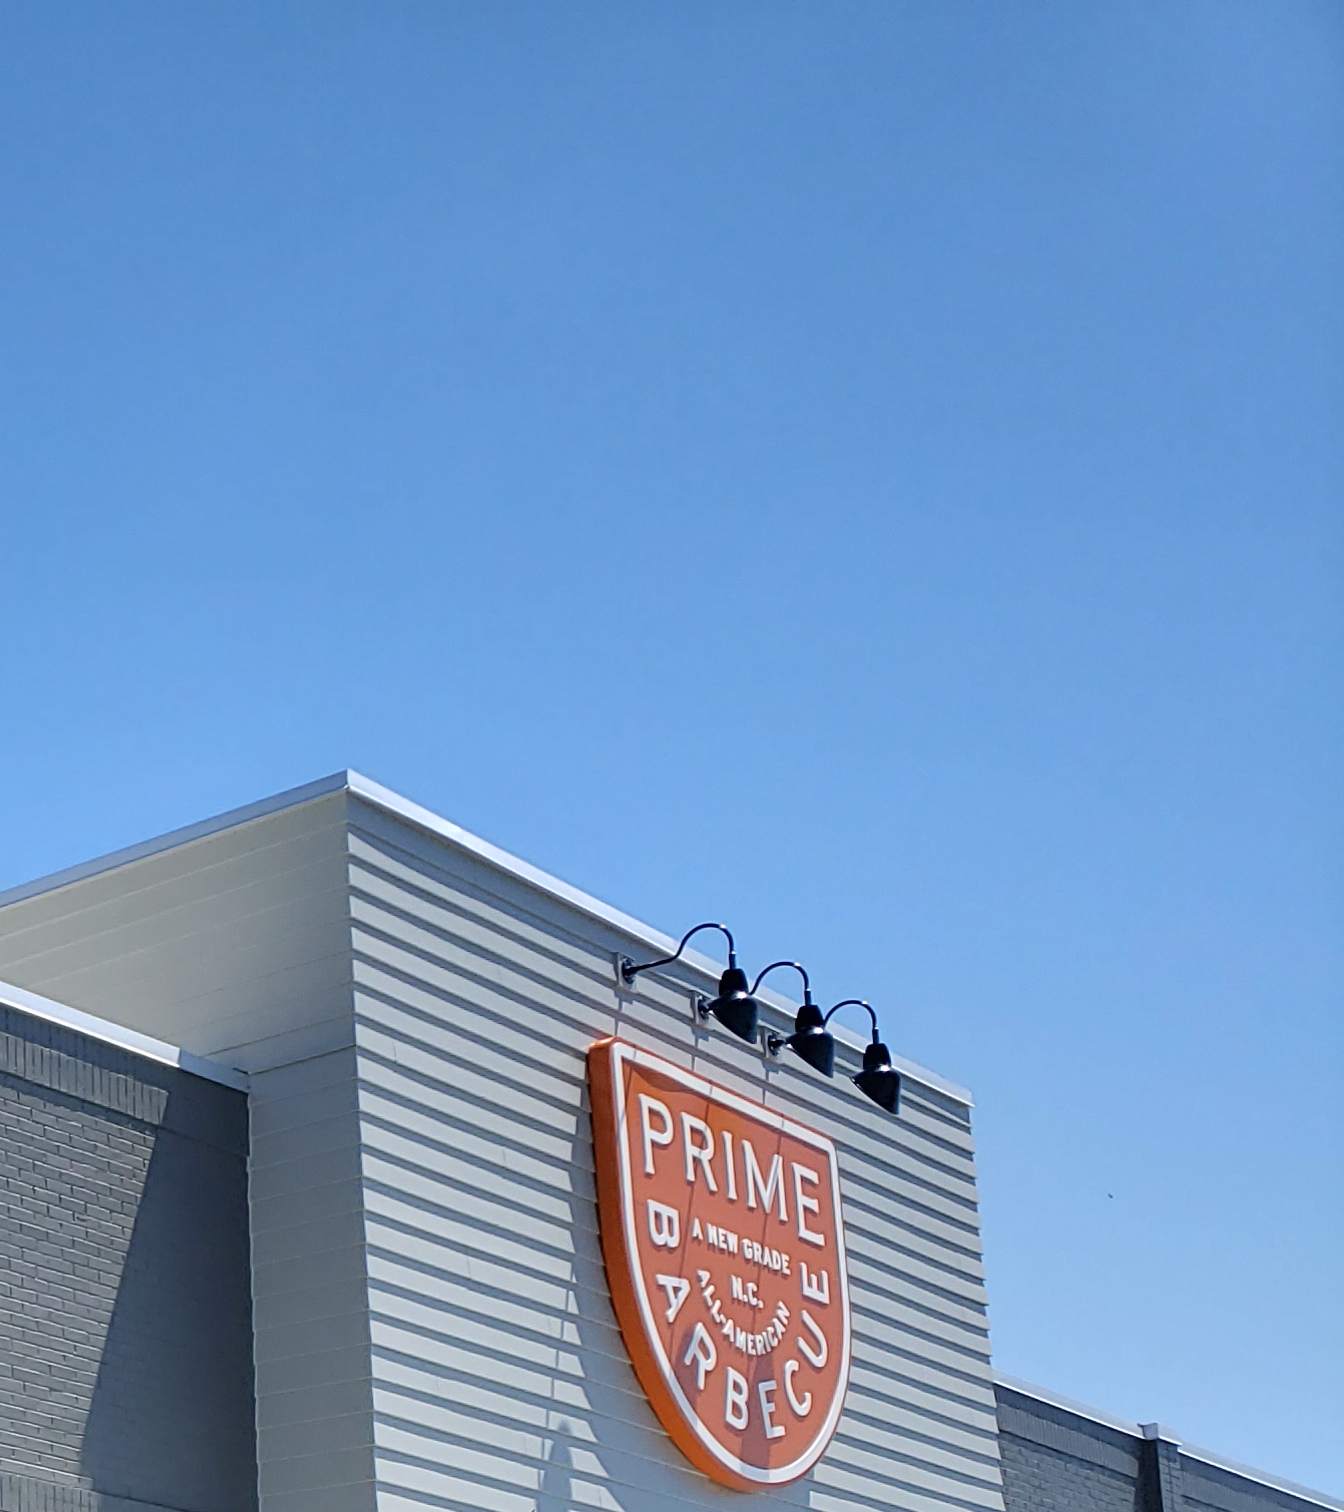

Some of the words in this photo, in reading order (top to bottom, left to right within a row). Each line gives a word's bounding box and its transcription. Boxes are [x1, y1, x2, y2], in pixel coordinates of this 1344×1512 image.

[637, 1092, 825, 1247] PRIME
[691, 1217, 703, 1242] A
[706, 1224, 738, 1254] NEW
[741, 1238, 791, 1276] GRADE
[646, 1199, 830, 1439] BARBECUE
[696, 1269, 791, 1357] ALL-AMERICAN
[730, 1274, 764, 1309] N.C.
